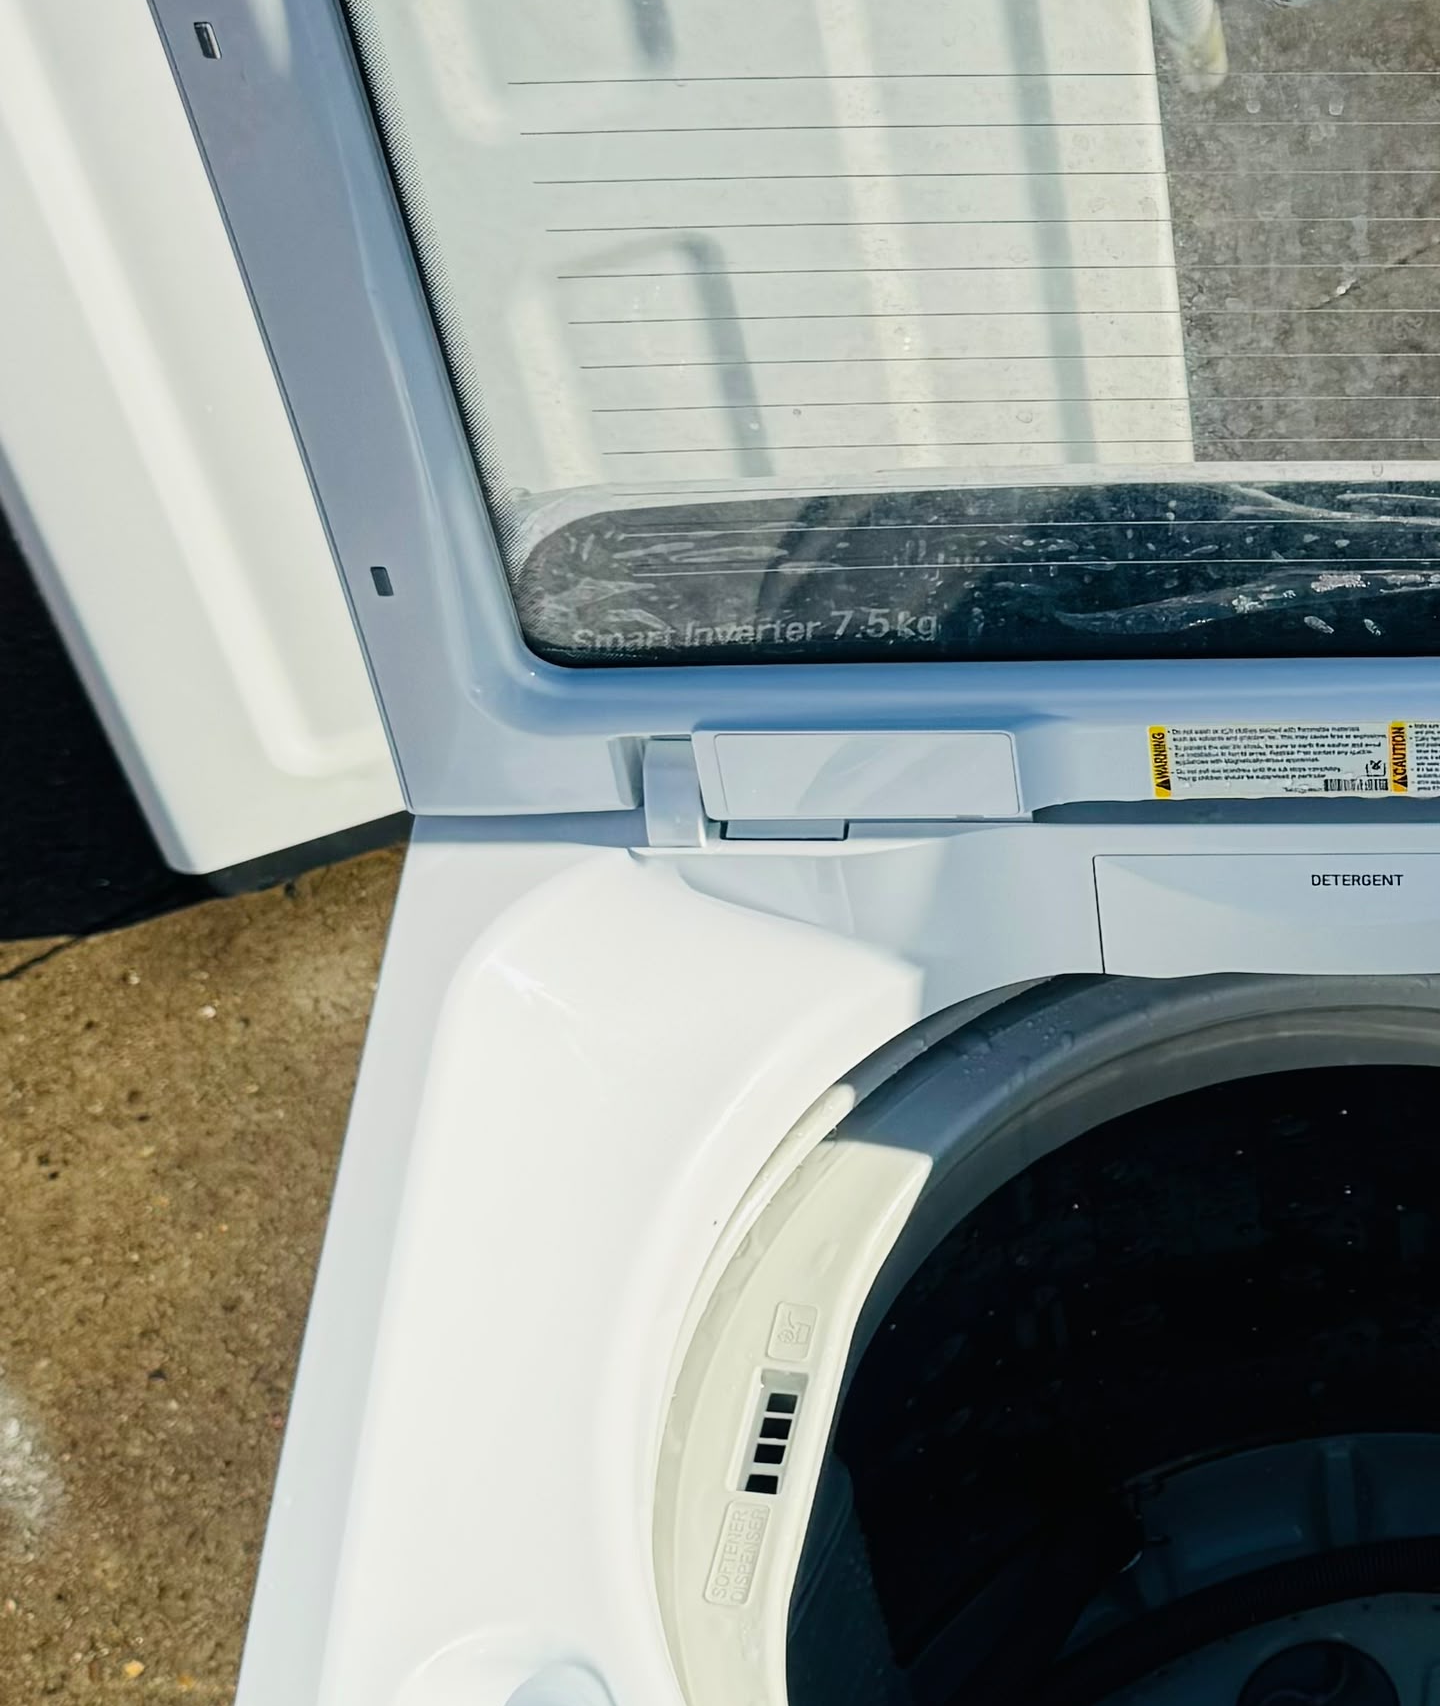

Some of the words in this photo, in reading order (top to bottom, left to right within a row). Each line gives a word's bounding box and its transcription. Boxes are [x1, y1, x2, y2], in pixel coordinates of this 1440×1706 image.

[684, 617, 823, 645] Inverter
[1154, 731, 1170, 780] WARNING
[1392, 726, 1407, 775] CAUTION
[1310, 873, 1404, 887] DETERGENT
[711, 1508, 748, 1600] SOFTENER
[731, 1507, 769, 1603] DISPENSER
